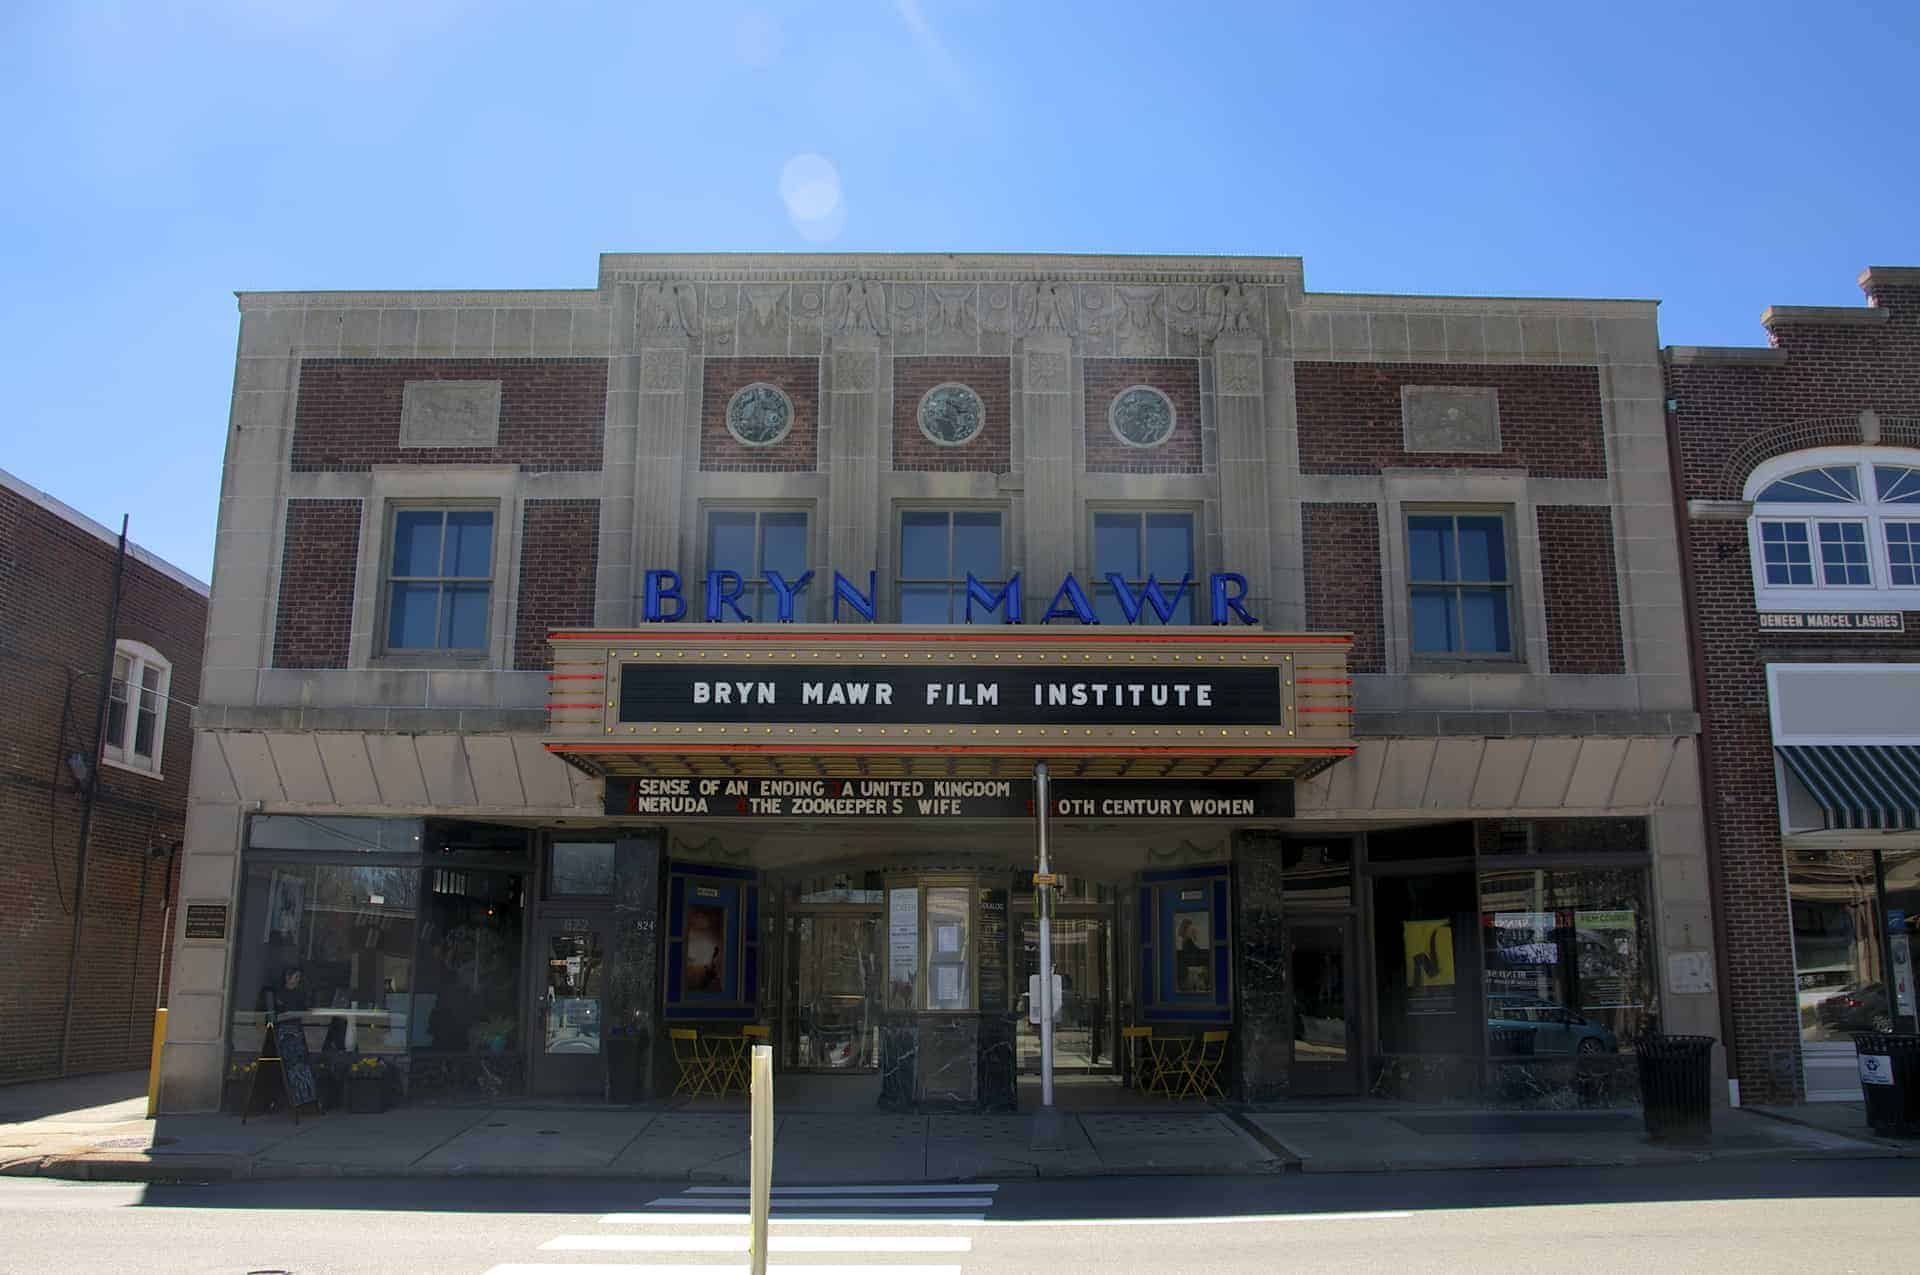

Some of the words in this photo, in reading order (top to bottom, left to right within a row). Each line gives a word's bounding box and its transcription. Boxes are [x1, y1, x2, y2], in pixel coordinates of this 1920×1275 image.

[644, 569, 877, 623] BRYN
[965, 570, 1259, 625] MAWR
[1759, 614, 1802, 627] DENEEN
[1807, 614, 1853, 628] MARCEL
[1856, 614, 1899, 628] LASHES
[693, 681, 777, 704] BRYN
[802, 681, 893, 705] MAWR
[926, 682, 999, 706] FILM
[1034, 682, 1213, 707] INSTITUTE
[638, 779, 690, 796] SENSE
[699, 779, 720, 796] OF
[724, 780, 749, 796] AN
[760, 780, 825, 797] ENDING
[841, 781, 854, 797] A
[861, 781, 923, 797] UNITED
[934, 781, 1010, 798] KINGDOM
[638, 797, 708, 813] NERUDA
[749, 798, 781, 814] THE
[792, 798, 887, 815] ZOOKEEPER
[918, 799, 962, 816] WIFE
[1102, 799, 1184, 816] CENTURY
[1190, 799, 1255, 816] WOMEN
